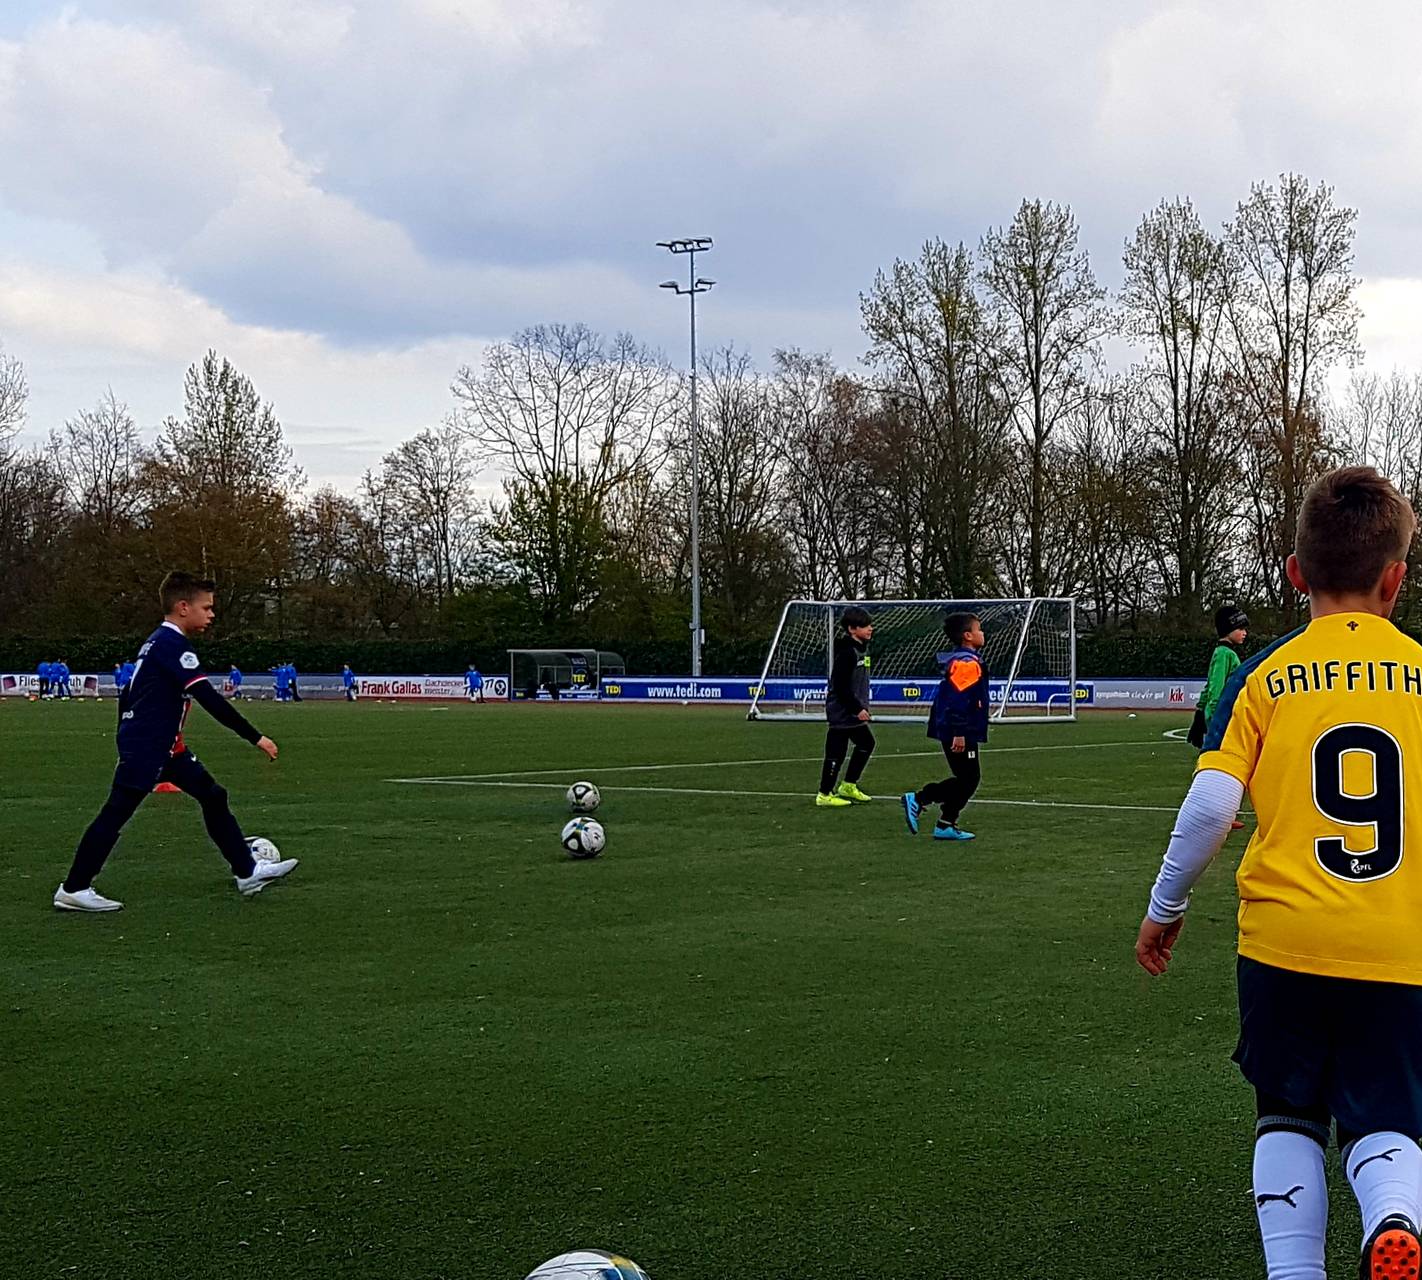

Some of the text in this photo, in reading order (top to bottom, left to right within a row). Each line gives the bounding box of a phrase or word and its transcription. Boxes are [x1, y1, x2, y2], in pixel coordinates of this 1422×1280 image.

[361, 680, 422, 695] Frank Gallas
[647, 683, 722, 698] www.tedi.com
[1169, 688, 1183, 702] kik
[1311, 722, 1404, 881] 9
